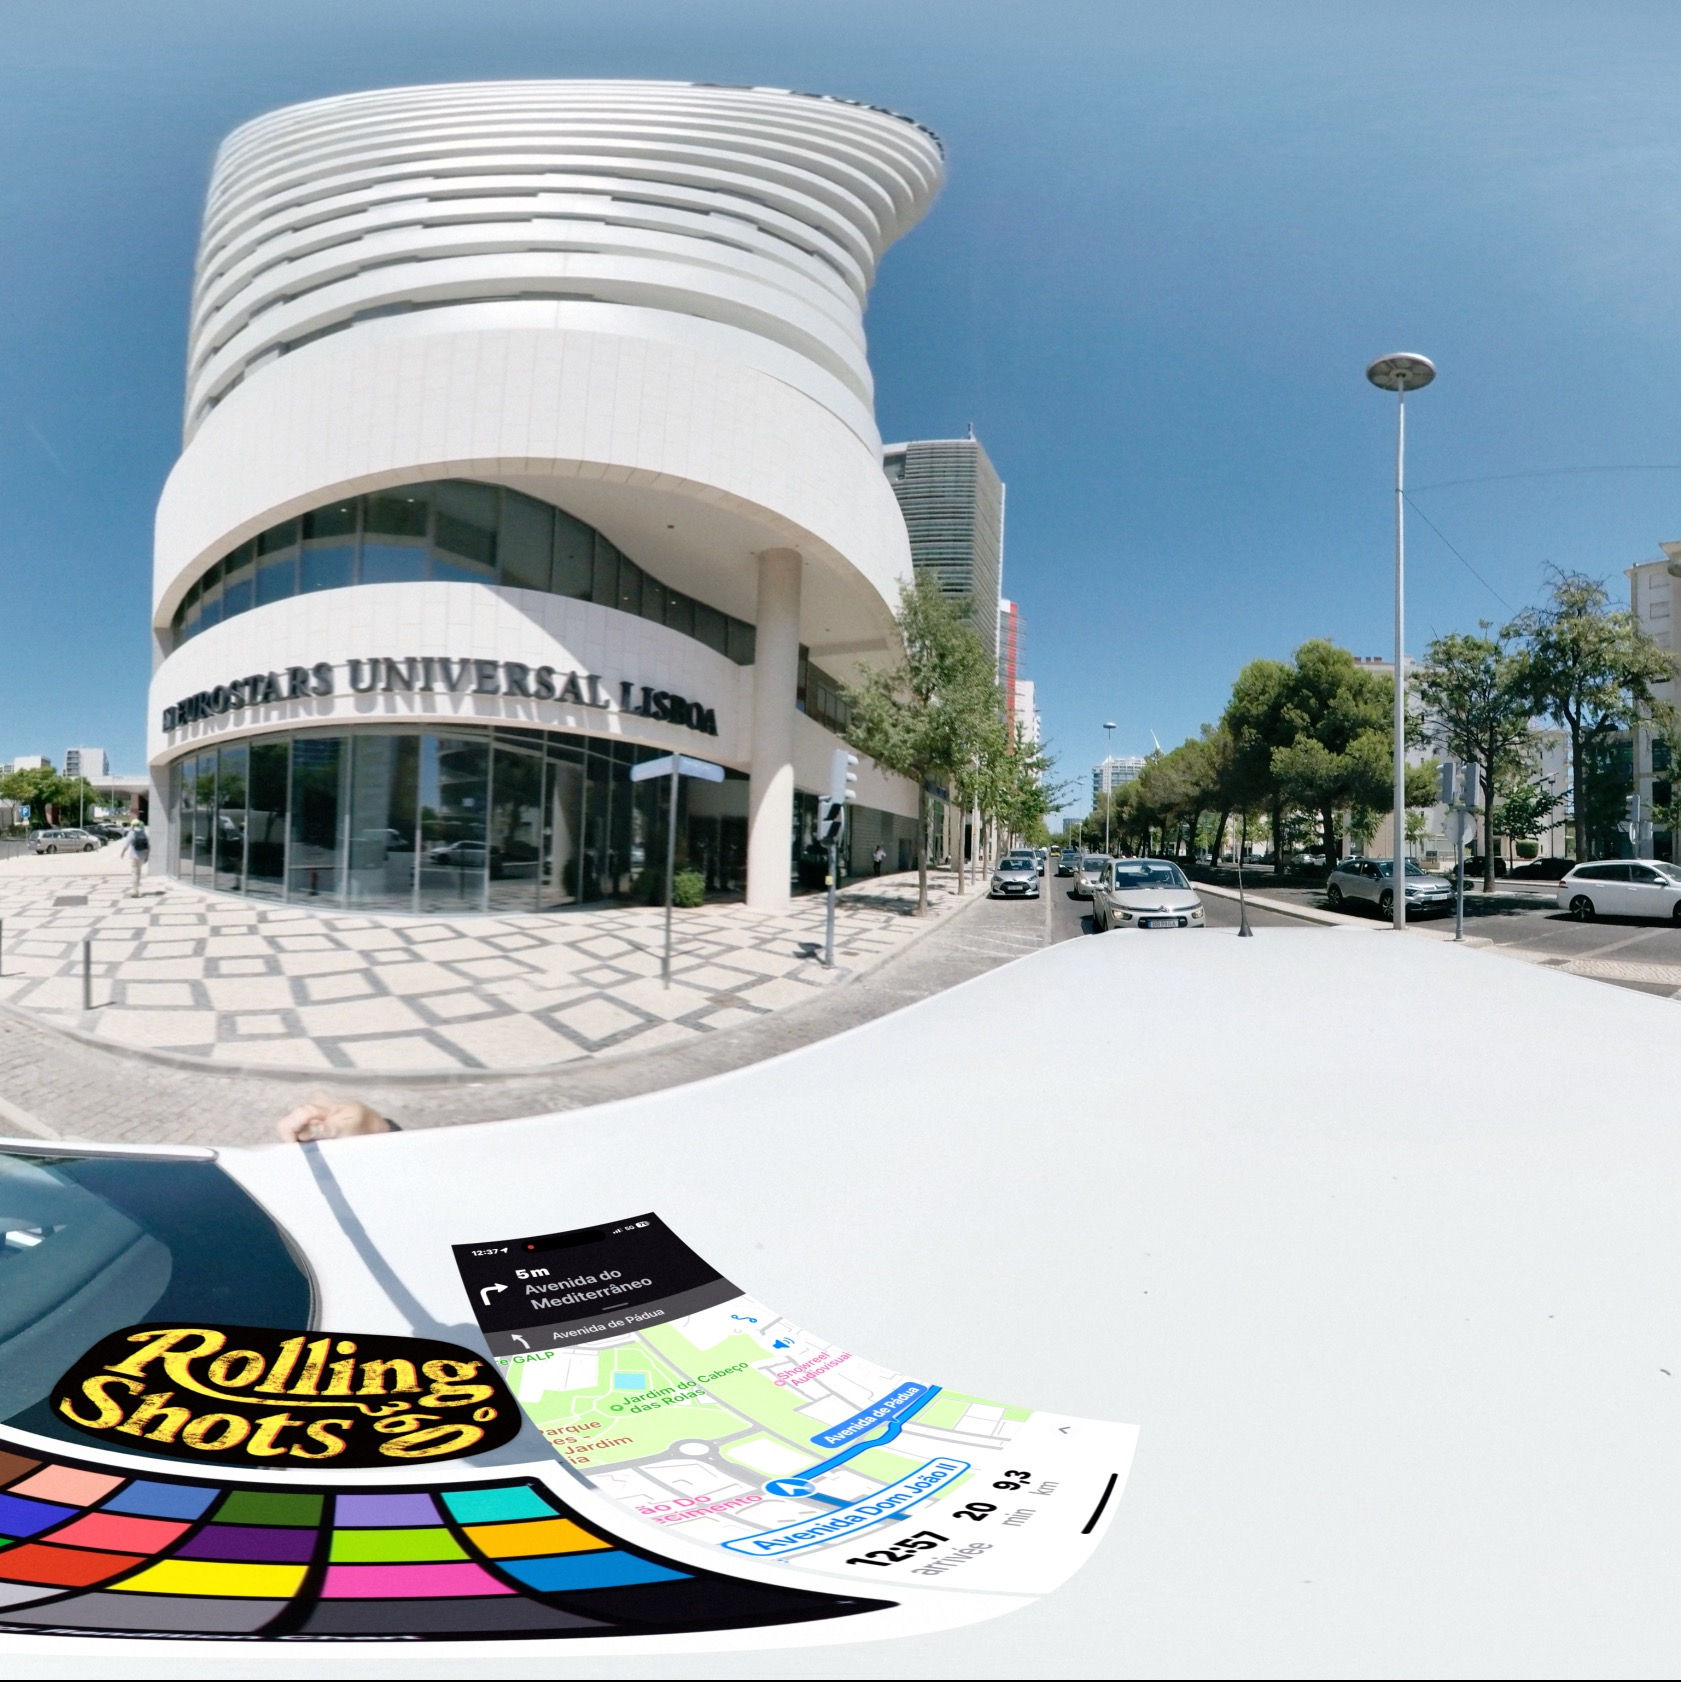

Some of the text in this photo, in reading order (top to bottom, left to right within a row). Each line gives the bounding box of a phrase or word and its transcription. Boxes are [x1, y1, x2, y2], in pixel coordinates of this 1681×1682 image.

[176, 656, 719, 736] EUROSTARS UNIVERSAL LISBOA
[471, 1247, 499, 1257] 12:37
[525, 1268, 622, 1295] Avenida do
[531, 1277, 653, 1310] Mediterrâneo
[552, 1307, 665, 1341] Avenida de Pádua
[513, 1351, 555, 1364] GALP
[777, 1351, 831, 1381] Showreel
[622, 1362, 749, 1406] Jardim do Cabeço
[630, 1387, 706, 1414] das Rolas
[824, 1386, 920, 1445] Avenida de Pádua
[565, 1435, 634, 1455] Jardim
[672, 1495, 711, 1508] Do
[752, 1462, 958, 1551] Avenida Dom João II
[846, 1469, 1032, 1567] 12:57 20 9,3
[911, 1479, 1060, 1576] arrivée min km
